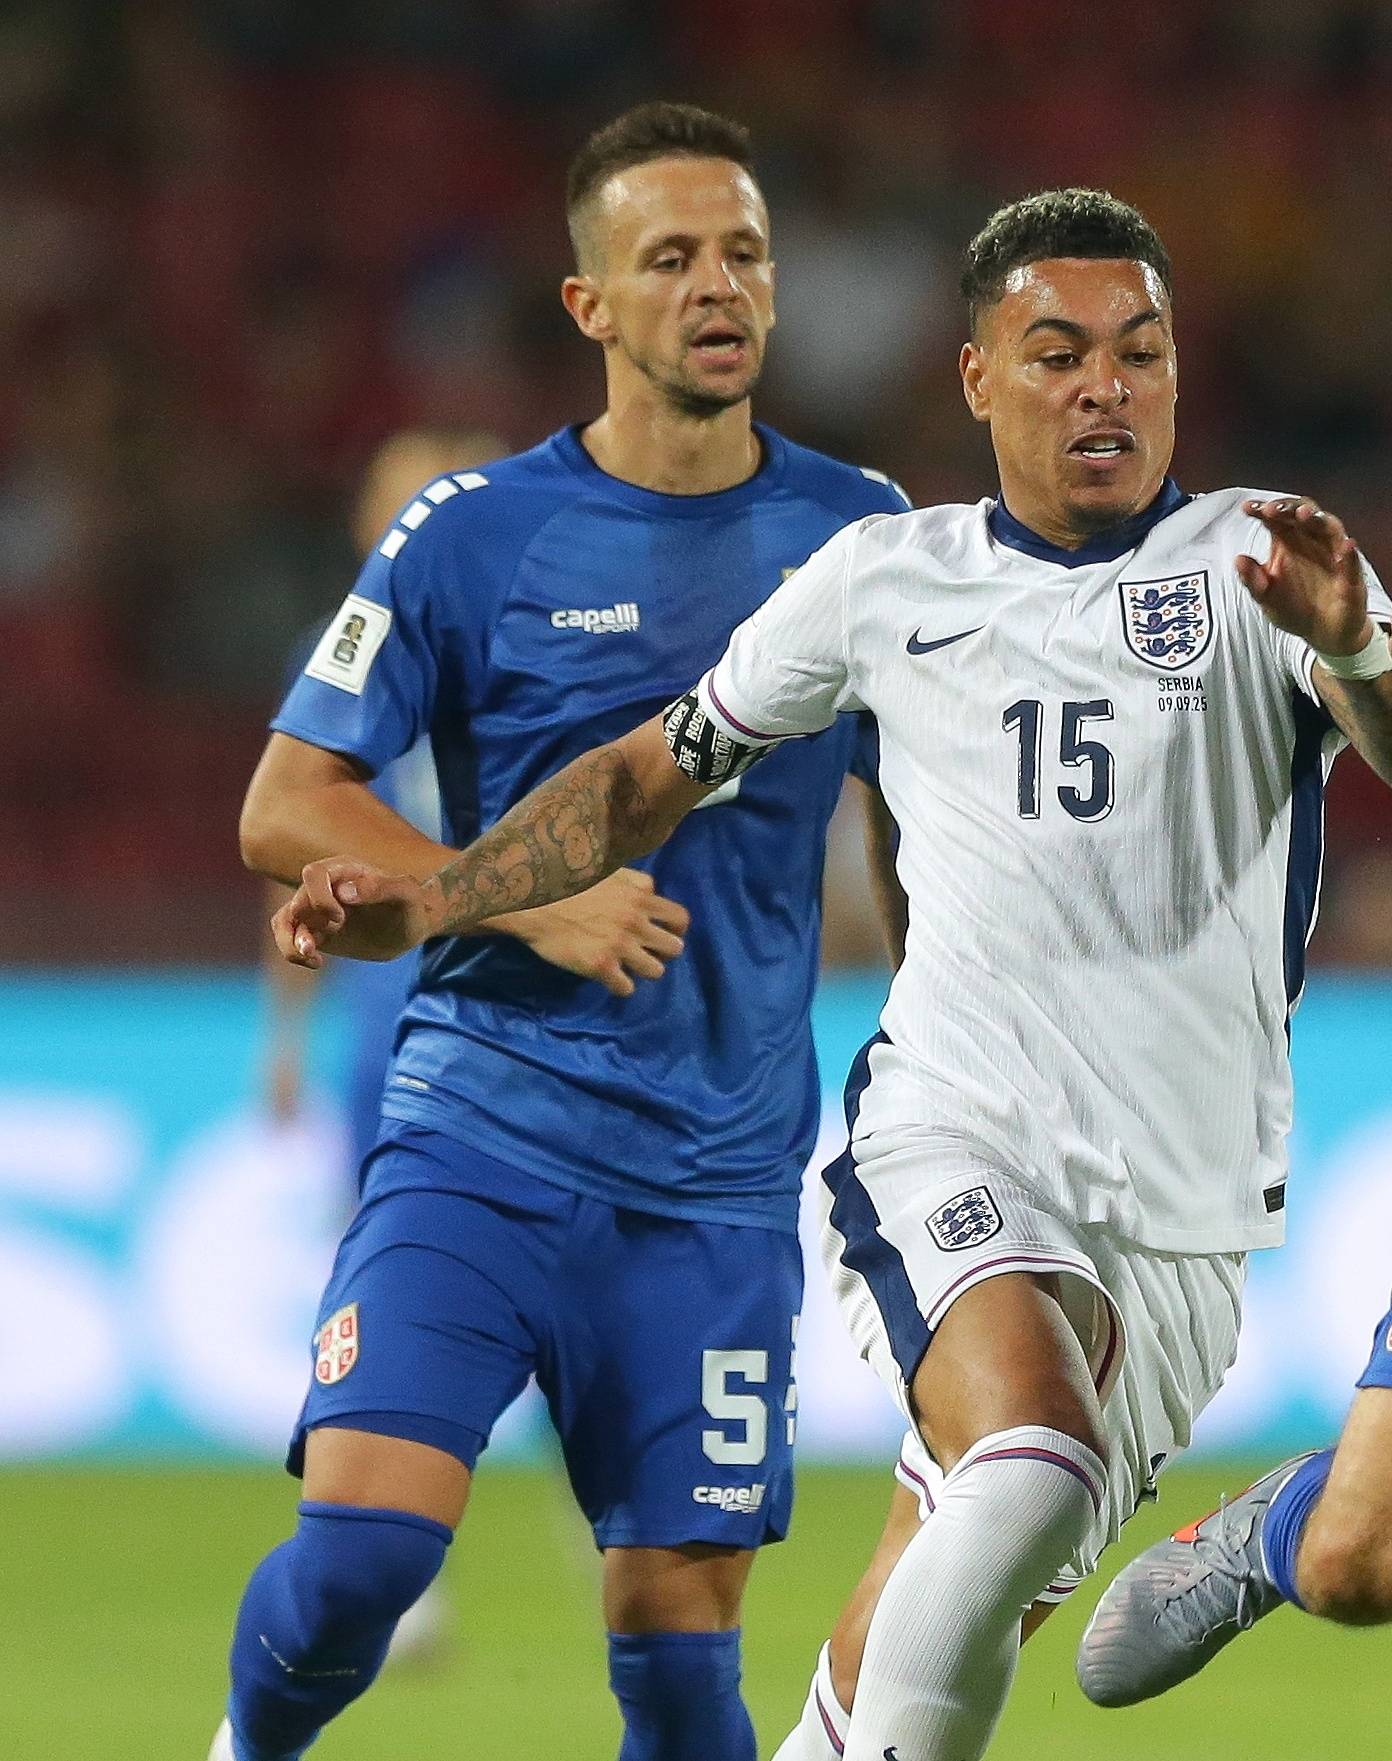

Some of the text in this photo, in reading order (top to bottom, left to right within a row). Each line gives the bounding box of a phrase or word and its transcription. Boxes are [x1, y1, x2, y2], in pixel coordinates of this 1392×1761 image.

[551, 603, 639, 632] capelli
[1158, 676, 1204, 691] SERBIA
[1158, 696, 1207, 711] 09.09.25
[1002, 699, 1115, 823] 15
[702, 1350, 768, 1465] 5
